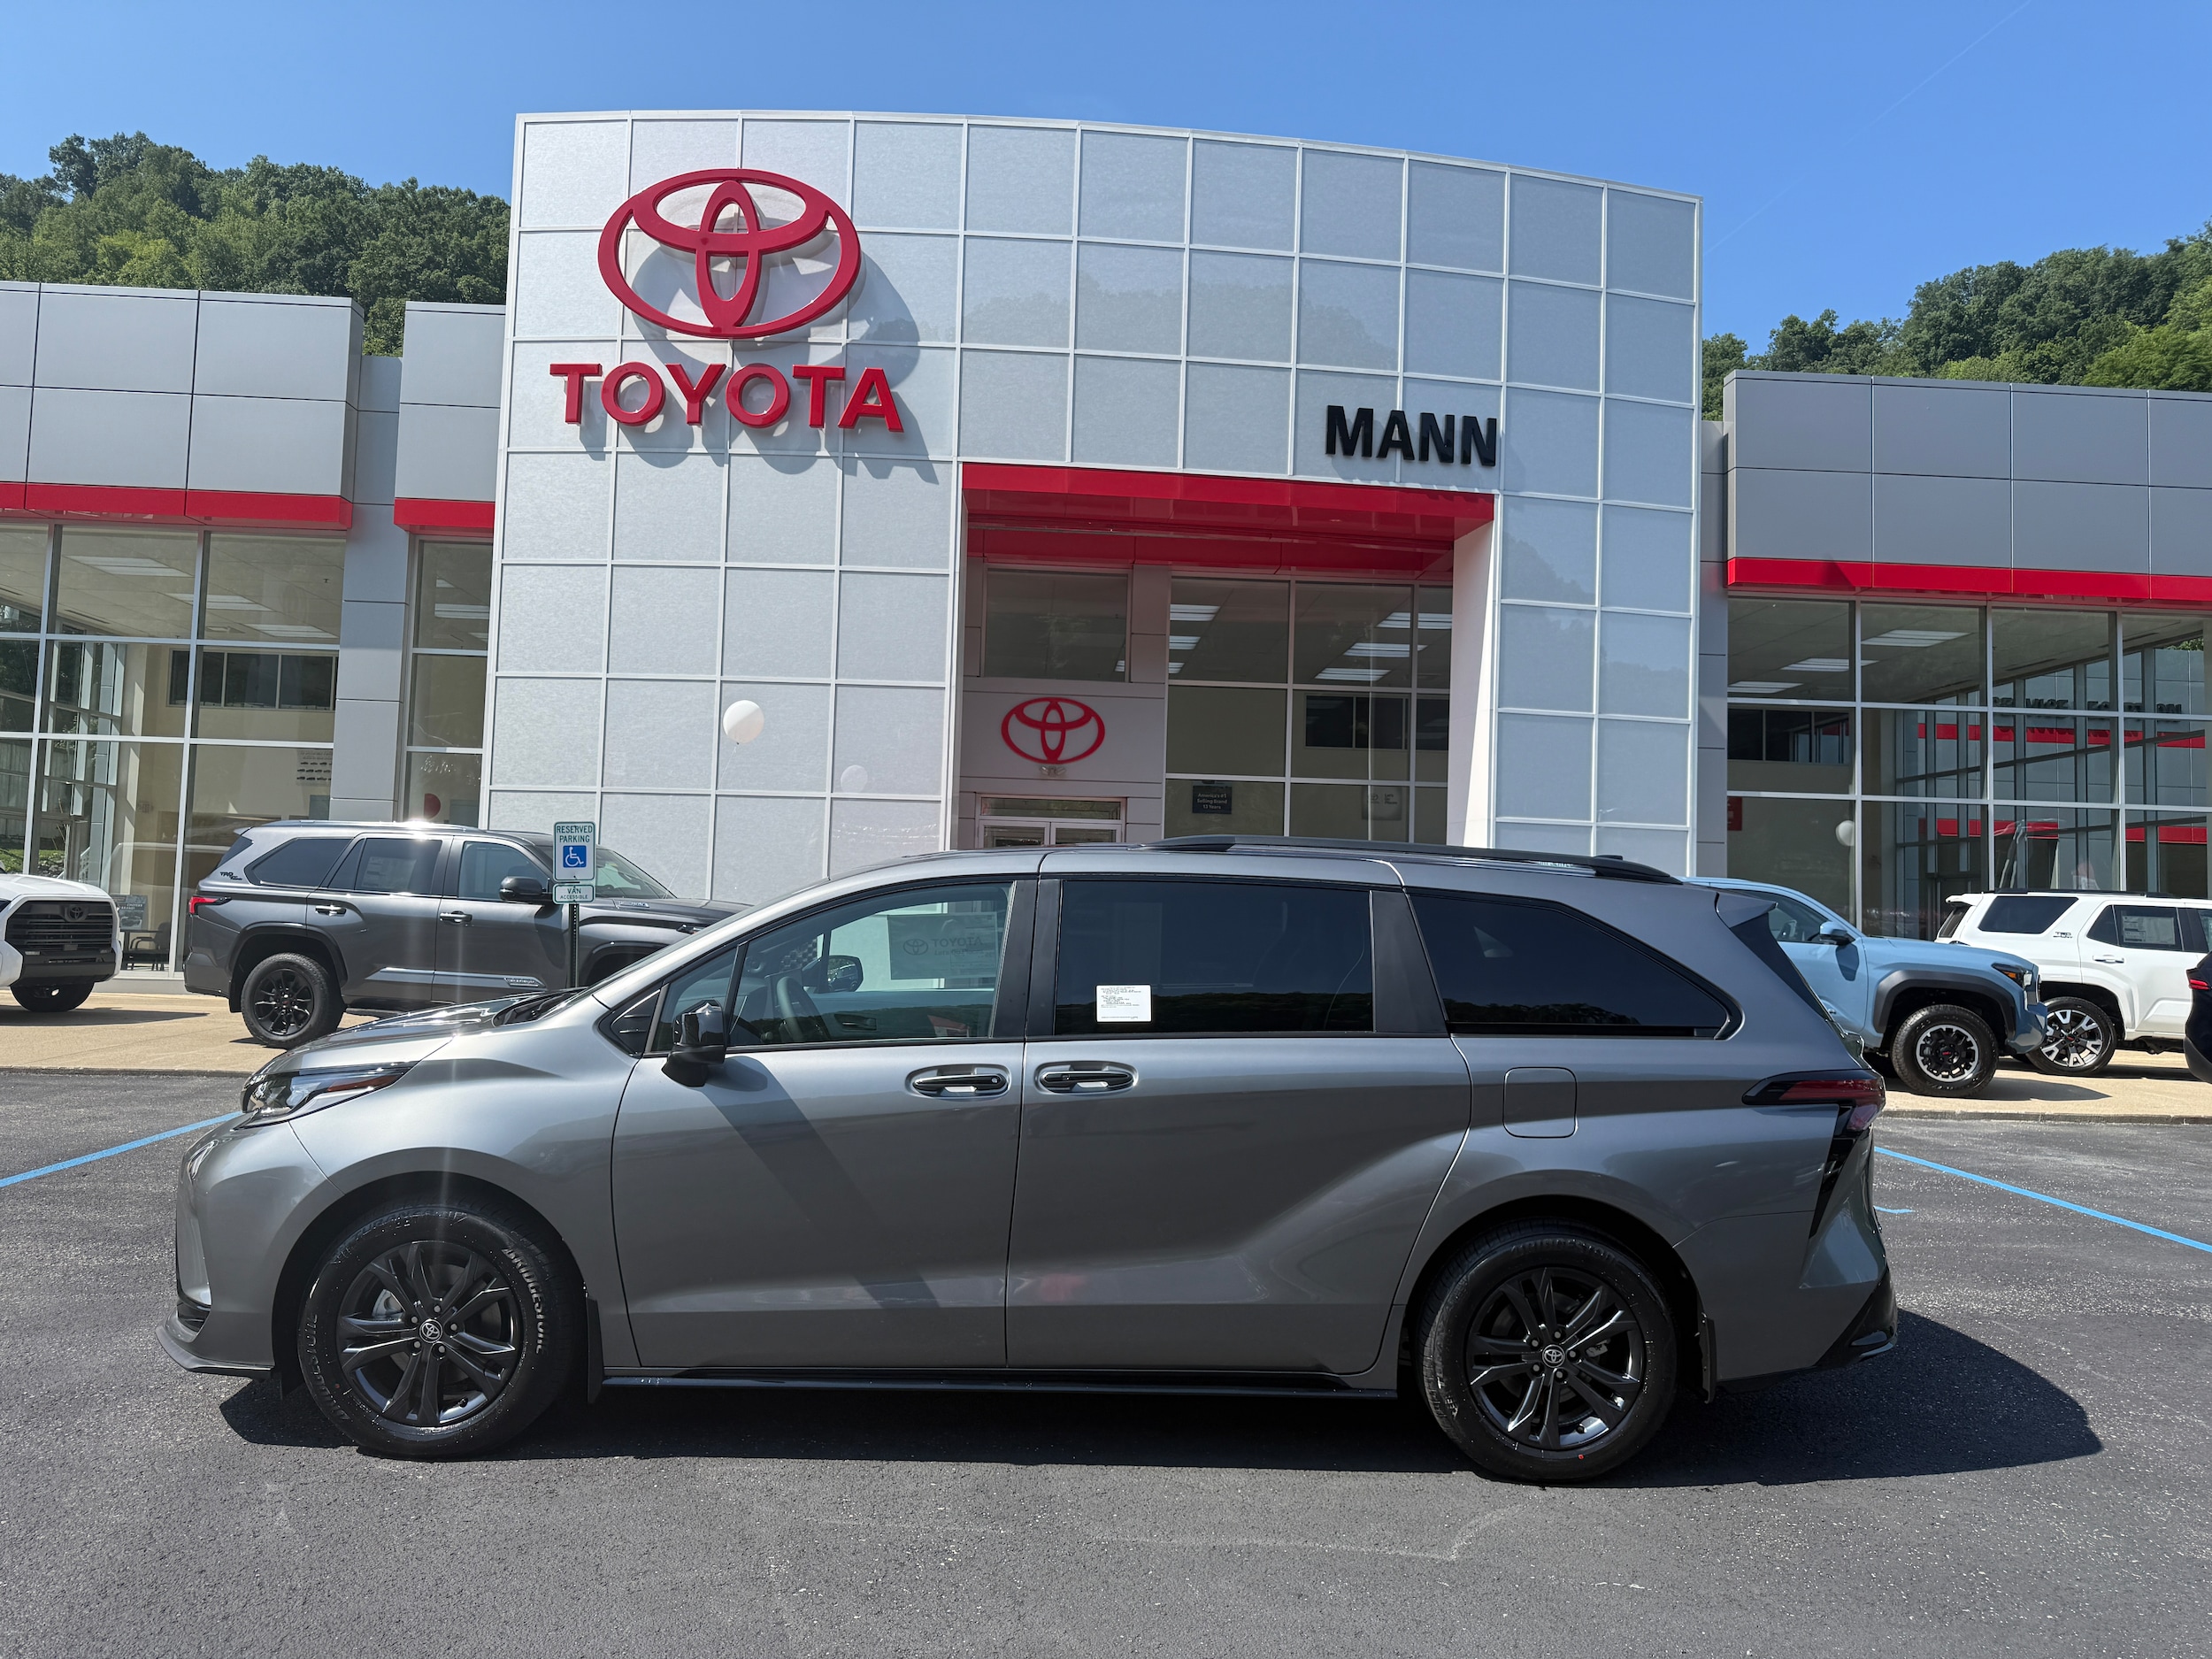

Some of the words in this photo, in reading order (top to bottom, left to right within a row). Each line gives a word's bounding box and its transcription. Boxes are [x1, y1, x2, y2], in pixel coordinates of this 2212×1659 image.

[550, 362, 903, 433] TOYOTA
[1325, 404, 1497, 466] MANN
[930, 936, 983, 948] TOYOTA
